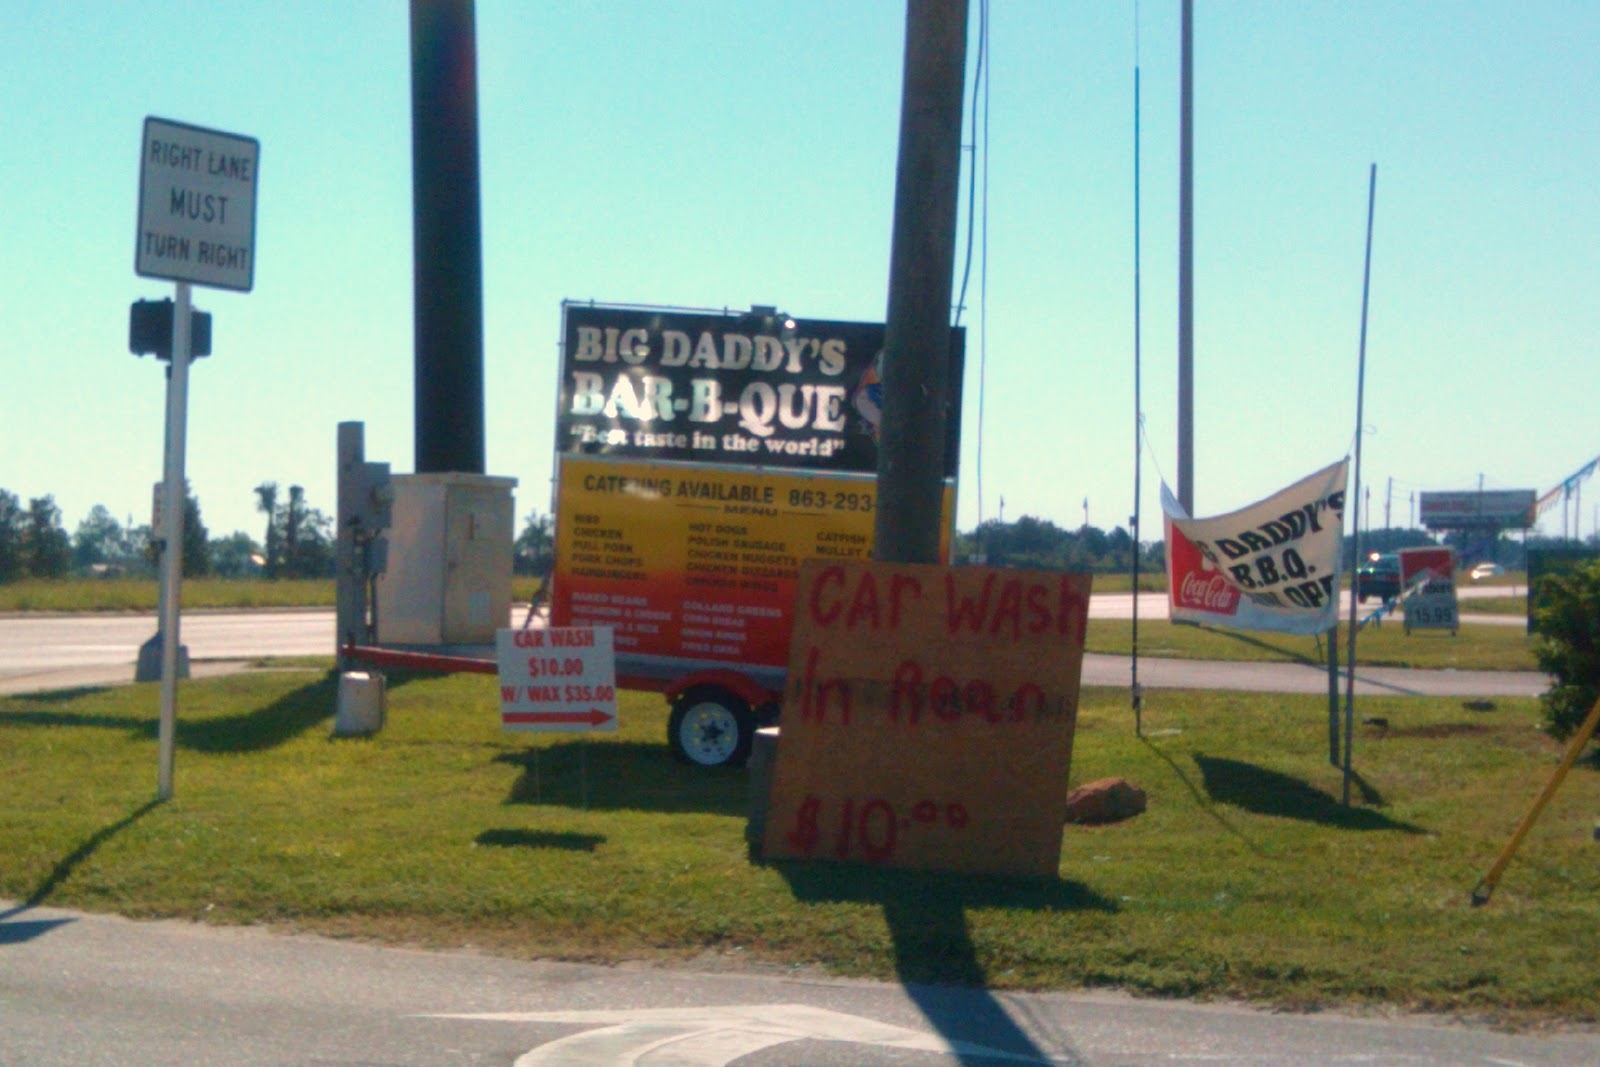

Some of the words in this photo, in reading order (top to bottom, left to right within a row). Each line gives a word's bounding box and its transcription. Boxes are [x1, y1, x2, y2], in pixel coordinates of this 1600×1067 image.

[151, 140, 202, 172] RIGHT
[208, 151, 250, 182] LANE
[170, 187, 228, 224] MUST
[145, 232, 191, 261] TURN
[198, 240, 248, 270] RIGHT
[574, 326, 650, 364] BIG
[660, 330, 847, 376] DADDY'S
[571, 370, 847, 437] BAR-B-QUE
[633, 431, 687, 449] taste
[692, 431, 716, 450] in
[722, 433, 759, 453] the
[584, 475, 672, 496] CATERING
[676, 481, 774, 504] AVAILABLE
[724, 505, 778, 516] MENU
[573, 527, 623, 539] CHICKEN
[688, 522, 712, 533] HOT
[716, 524, 748, 536] DOGS
[1214, 490, 1344, 561] DADDY'S
[513, 629, 545, 648] CAR
[549, 629, 595, 648] WASH
[527, 656, 584, 678] $10.00
[527, 685, 560, 702] WAX
[564, 684, 615, 703] $35.00
